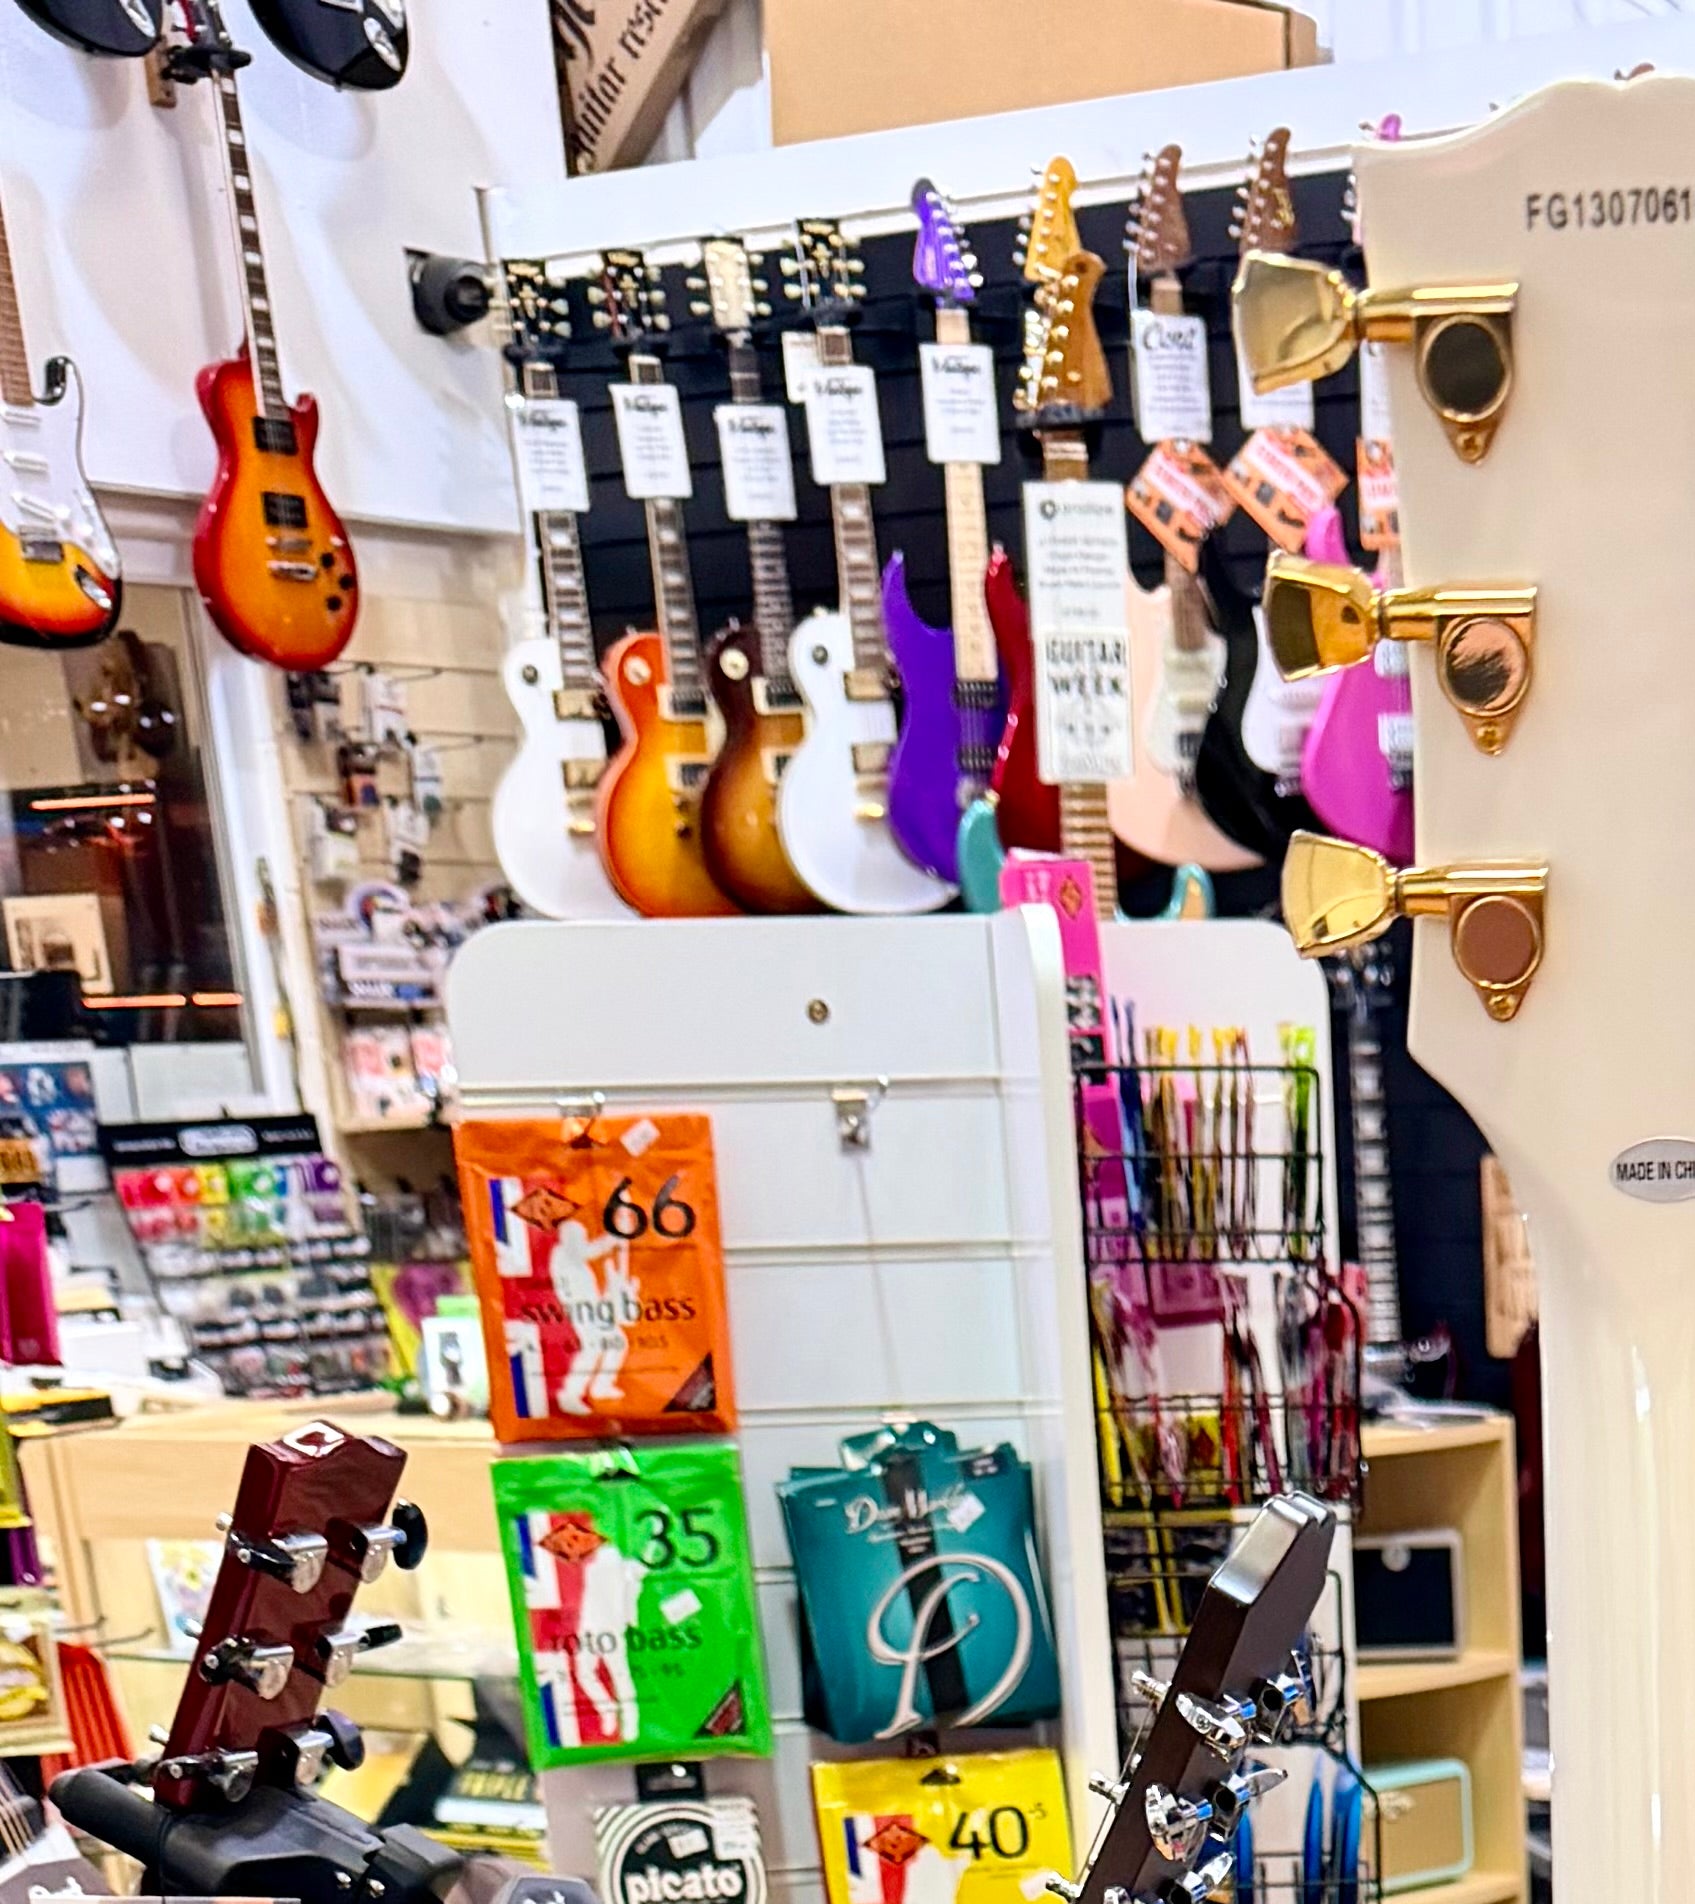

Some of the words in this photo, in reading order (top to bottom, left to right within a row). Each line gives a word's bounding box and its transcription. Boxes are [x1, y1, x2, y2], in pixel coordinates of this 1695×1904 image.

[1616, 1161, 1654, 1181] MADE
[1658, 1161, 1671, 1180] IN
[603, 1175, 695, 1240] 66
[521, 1294, 614, 1331] swing
[621, 1290, 696, 1322] bass
[636, 1506, 720, 1571] 35
[550, 1629, 618, 1656] roto
[626, 1623, 704, 1651] bass
[949, 1805, 1029, 1860] 40
